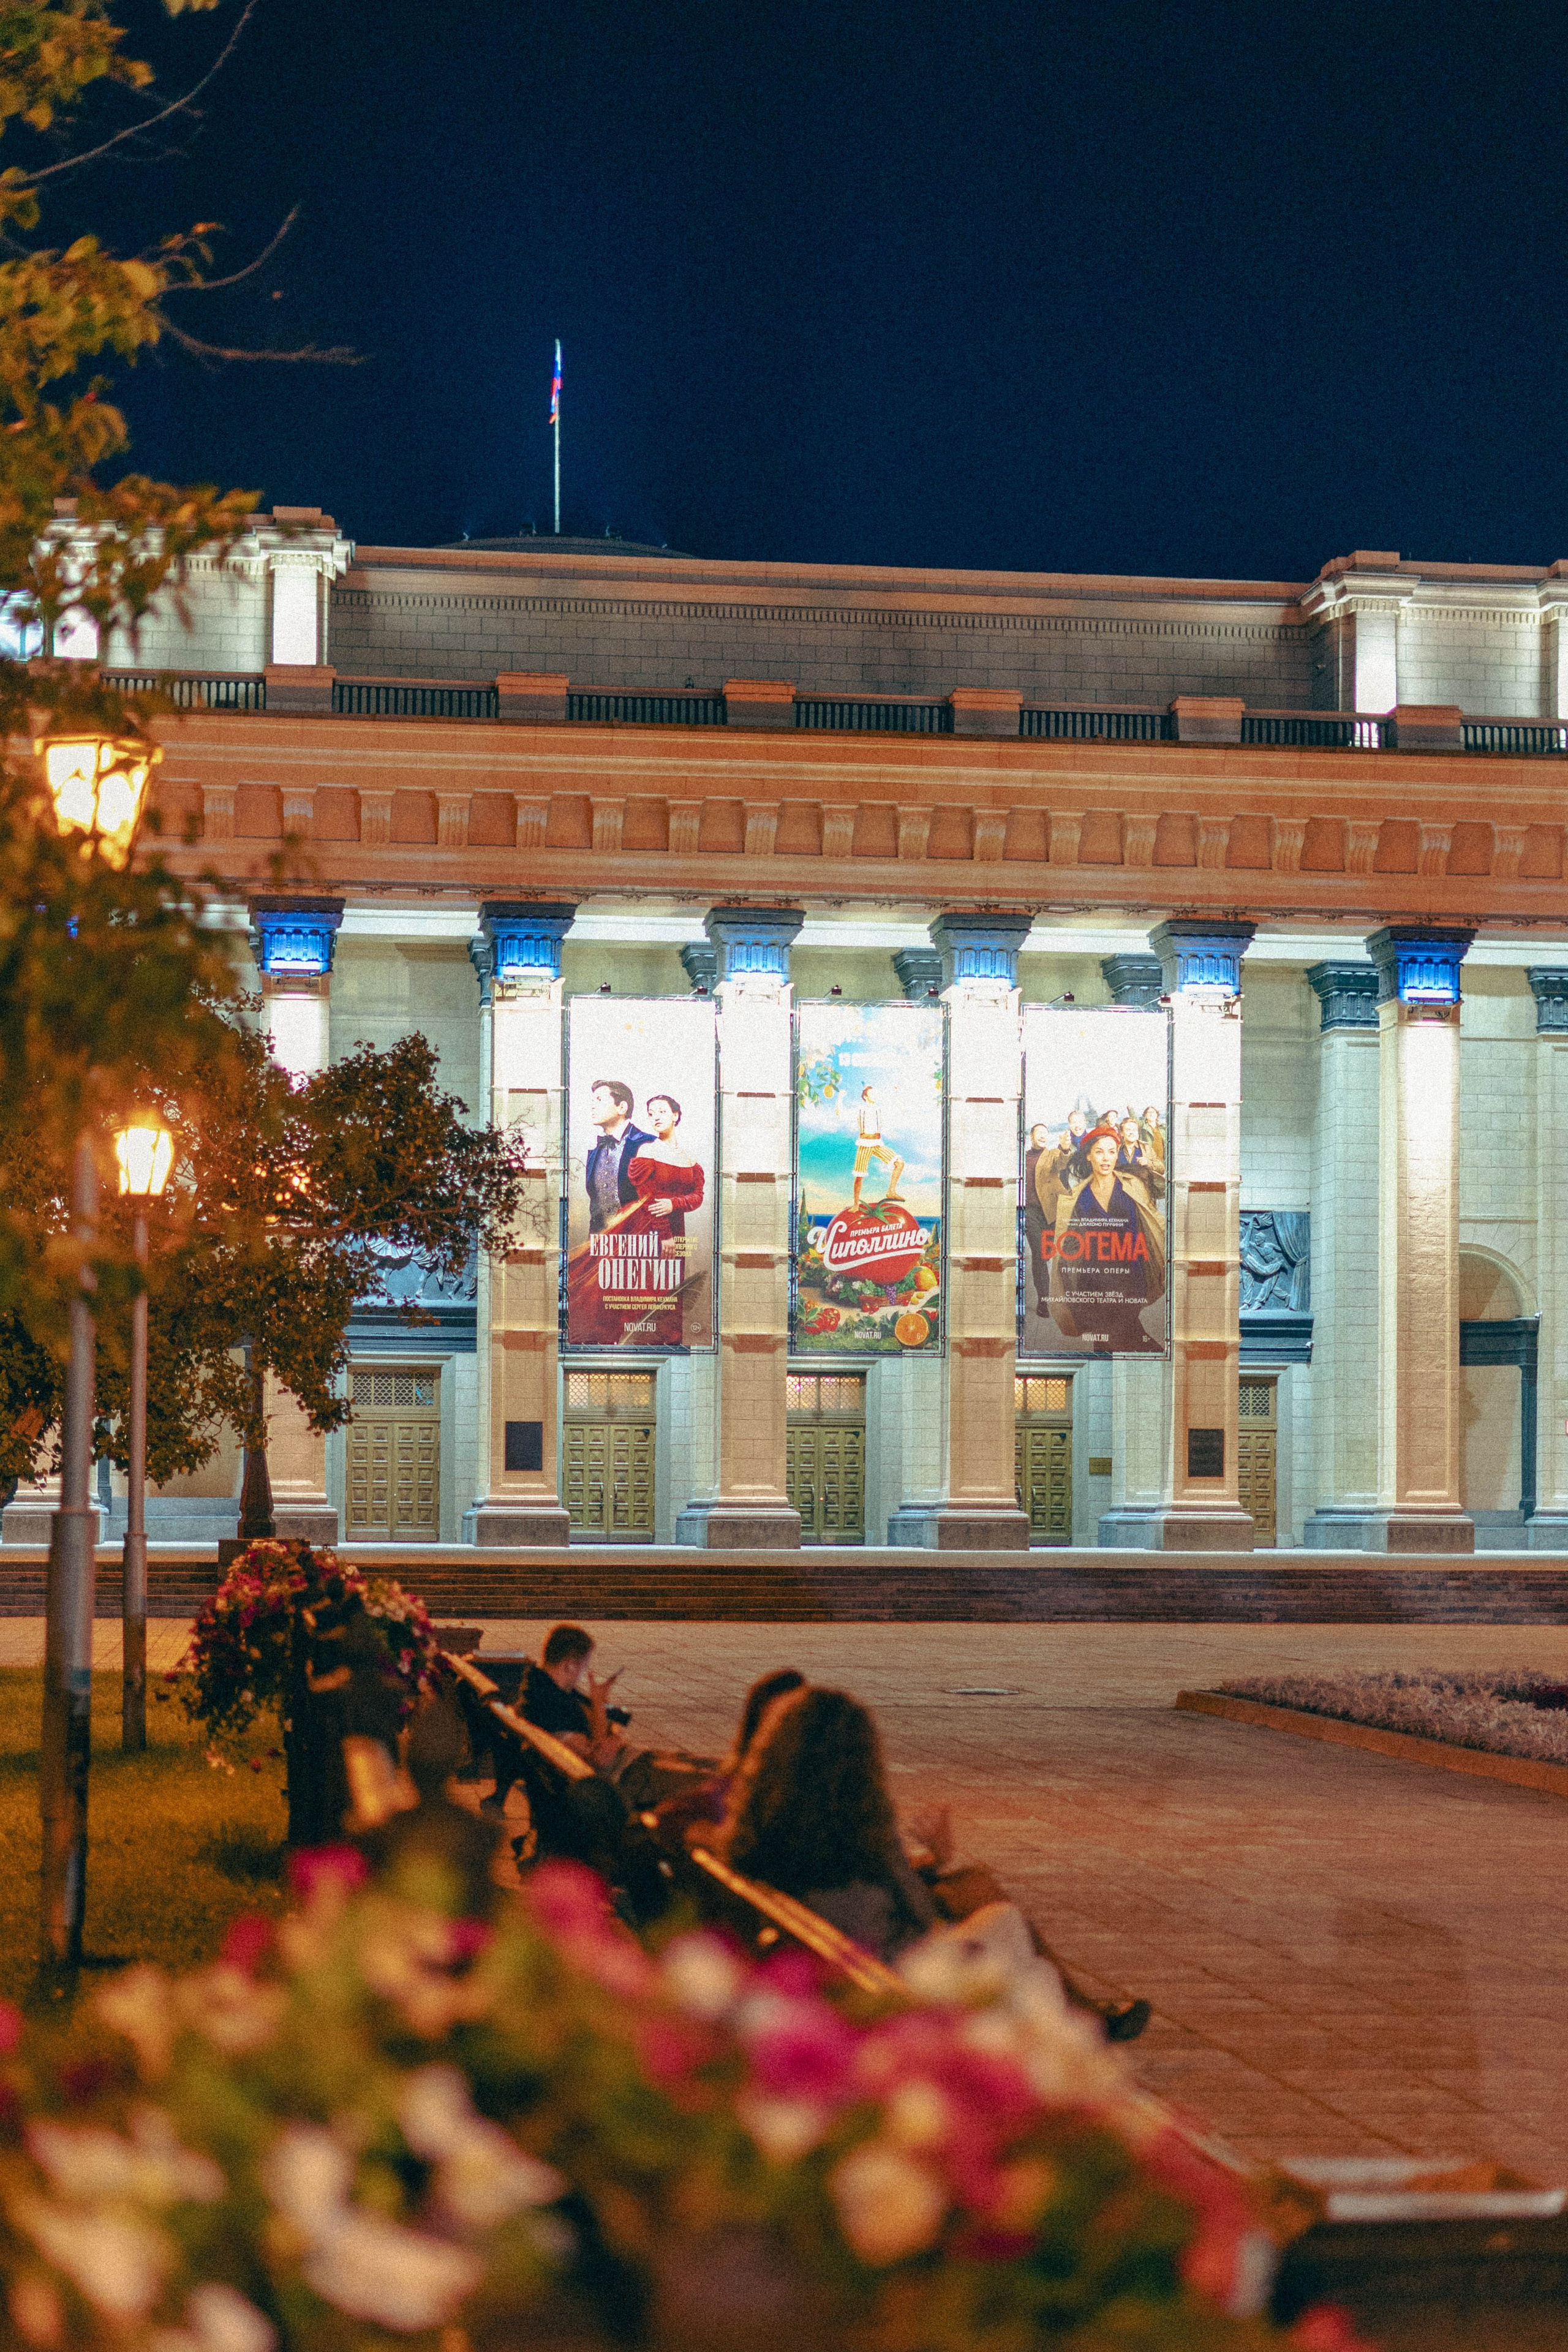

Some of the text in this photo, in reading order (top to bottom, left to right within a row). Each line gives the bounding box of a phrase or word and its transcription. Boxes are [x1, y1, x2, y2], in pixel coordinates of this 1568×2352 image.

[850, 1223, 903, 1237] ПРЕМЬЕРА БАЛЕТА
[590, 1231, 659, 1257] ЕВГЕНИЙ
[807, 1221, 930, 1272] Чиполлино
[1041, 1230, 1149, 1261] БОГЕМА
[598, 1258, 682, 1290] ОНЕГИН
[624, 1322, 656, 1332] NOVAT.RU
[854, 1331, 881, 1340] NOVAT.RU
[1082, 1333, 1109, 1342] NOVAT.RU
